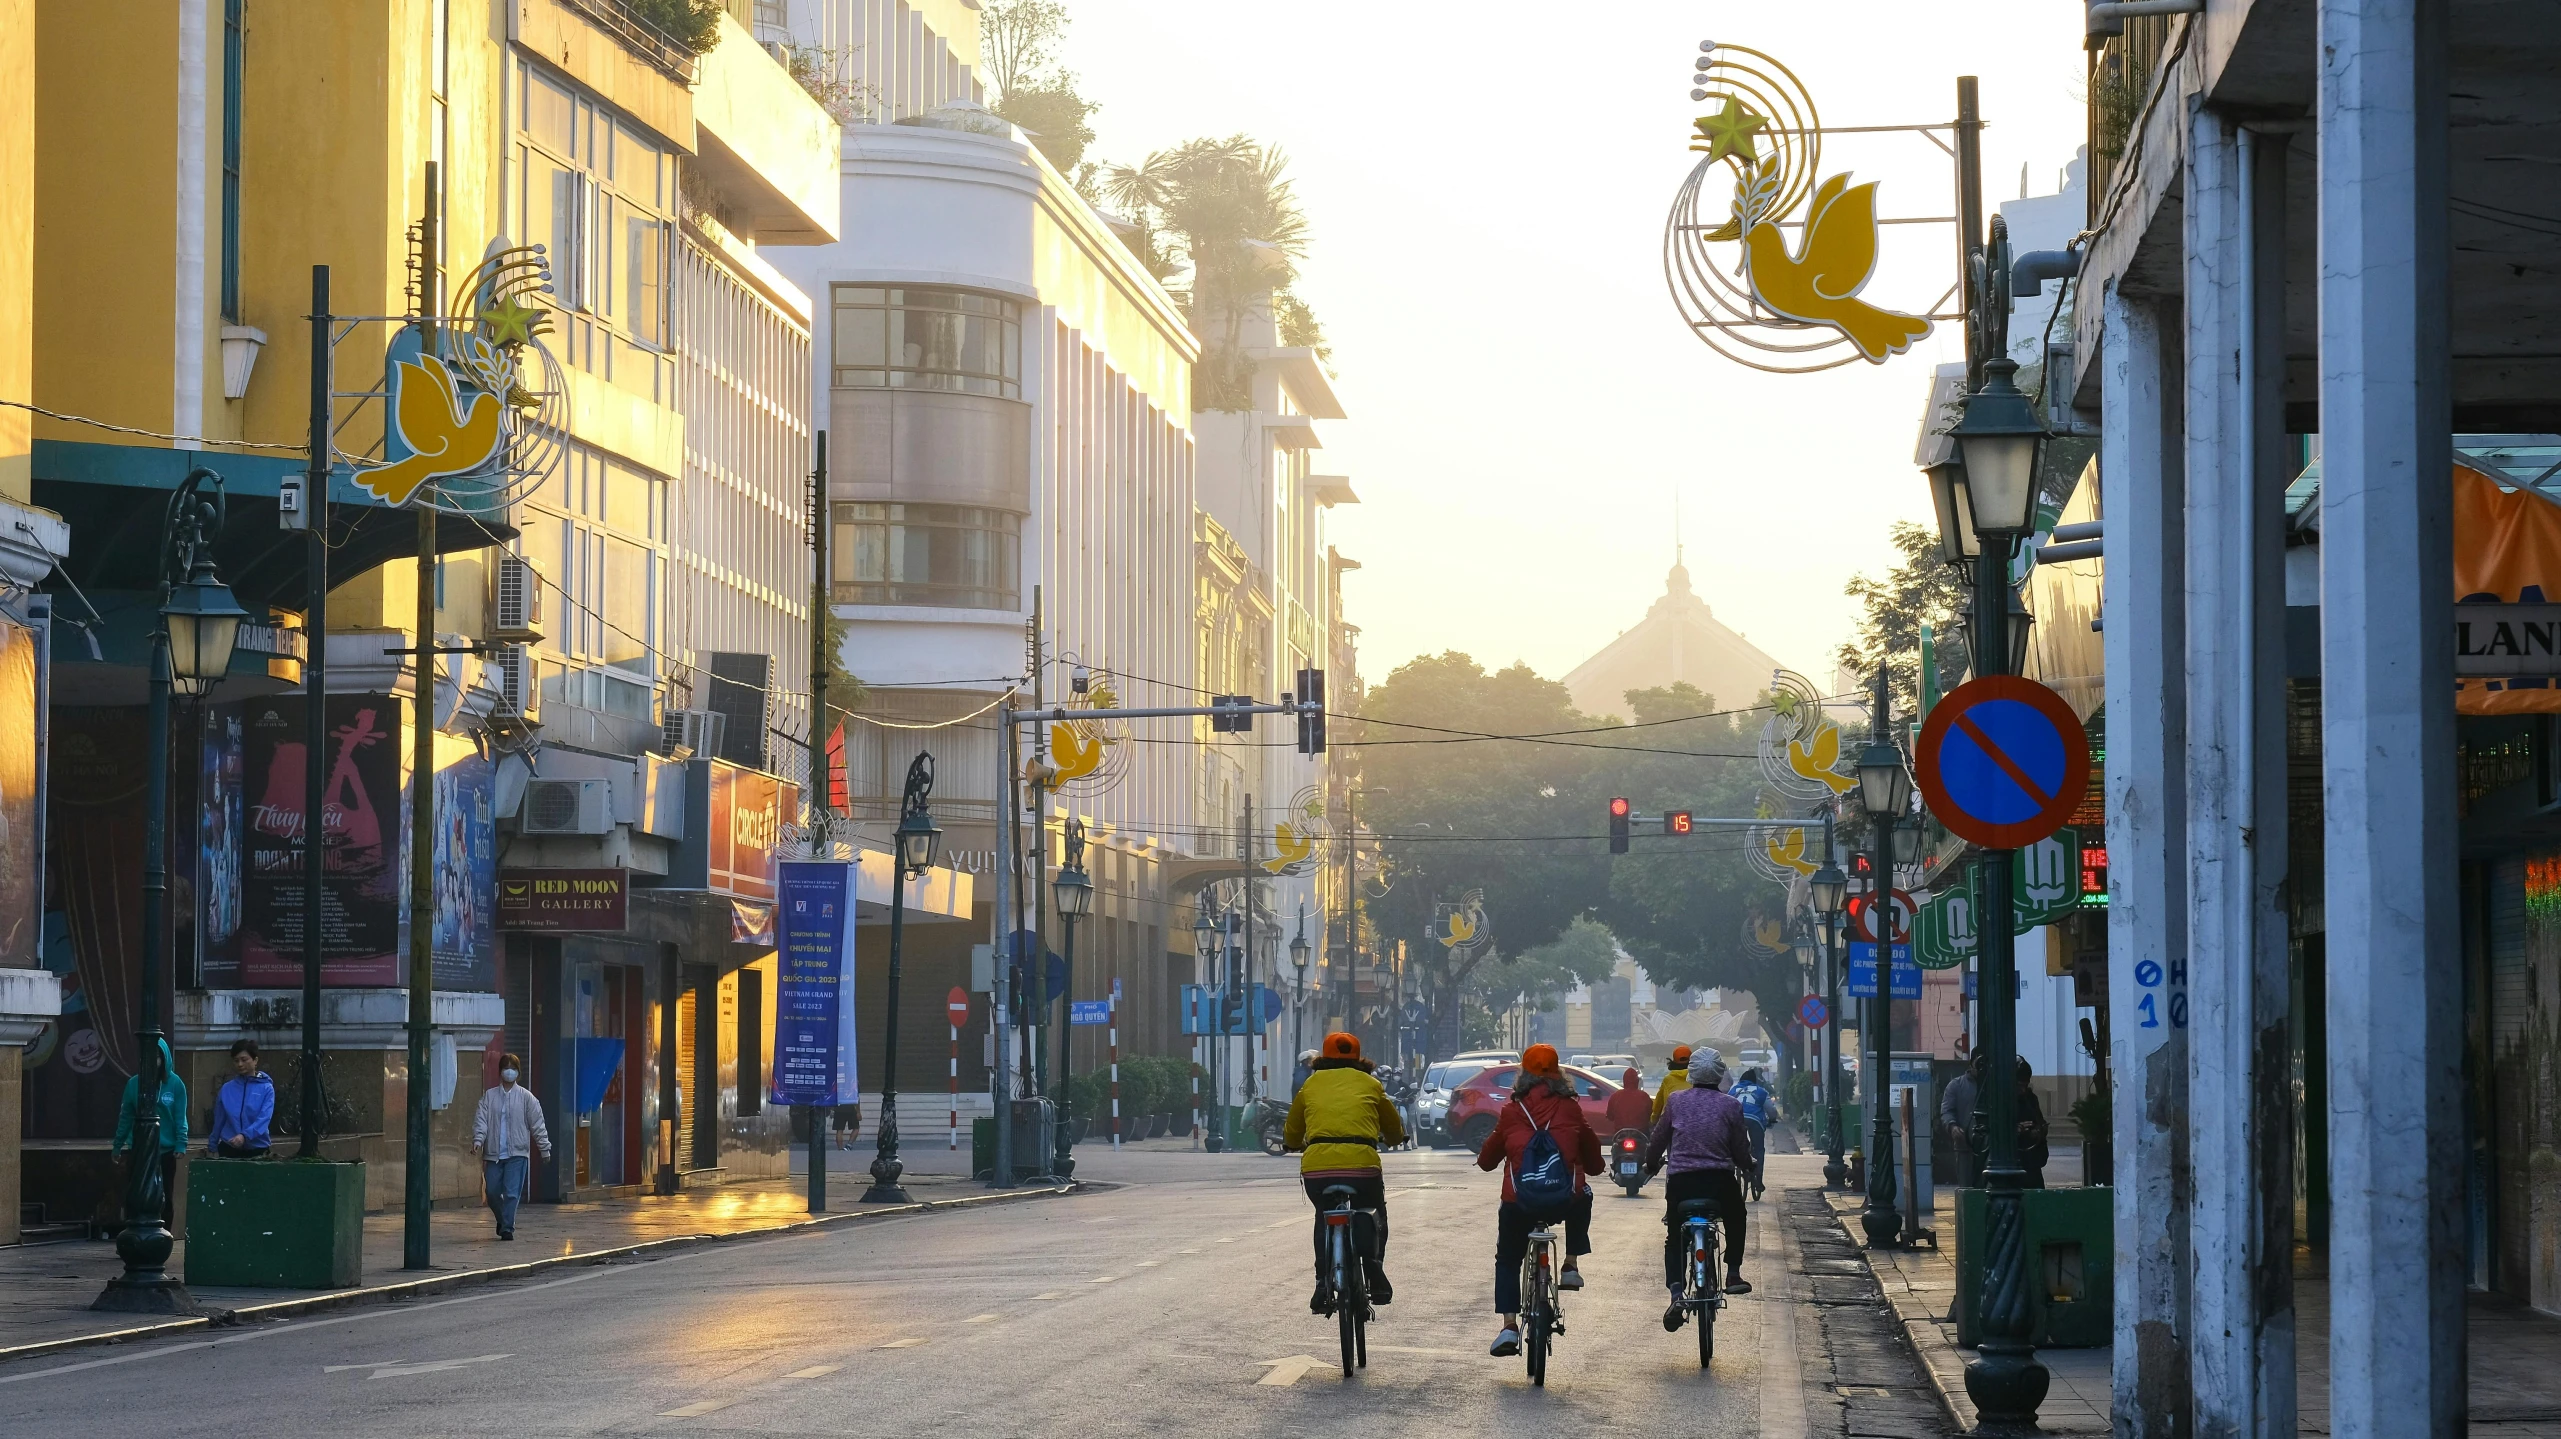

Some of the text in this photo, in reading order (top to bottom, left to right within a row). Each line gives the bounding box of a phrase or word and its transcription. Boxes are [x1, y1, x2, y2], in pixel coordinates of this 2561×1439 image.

[2454, 621, 2561, 656] LAN
[250, 804, 301, 839] Thúy
[736, 806, 764, 850] CIRCLE
[1675, 815, 1689, 831] 15
[948, 850, 1031, 875] VUITN
[535, 880, 619, 894] RED MOON
[541, 899, 613, 909] GALLERY
[804, 960, 828, 968] TRUNG
[804, 975, 817, 983] GIA
[784, 990, 810, 998] VIETNAM
